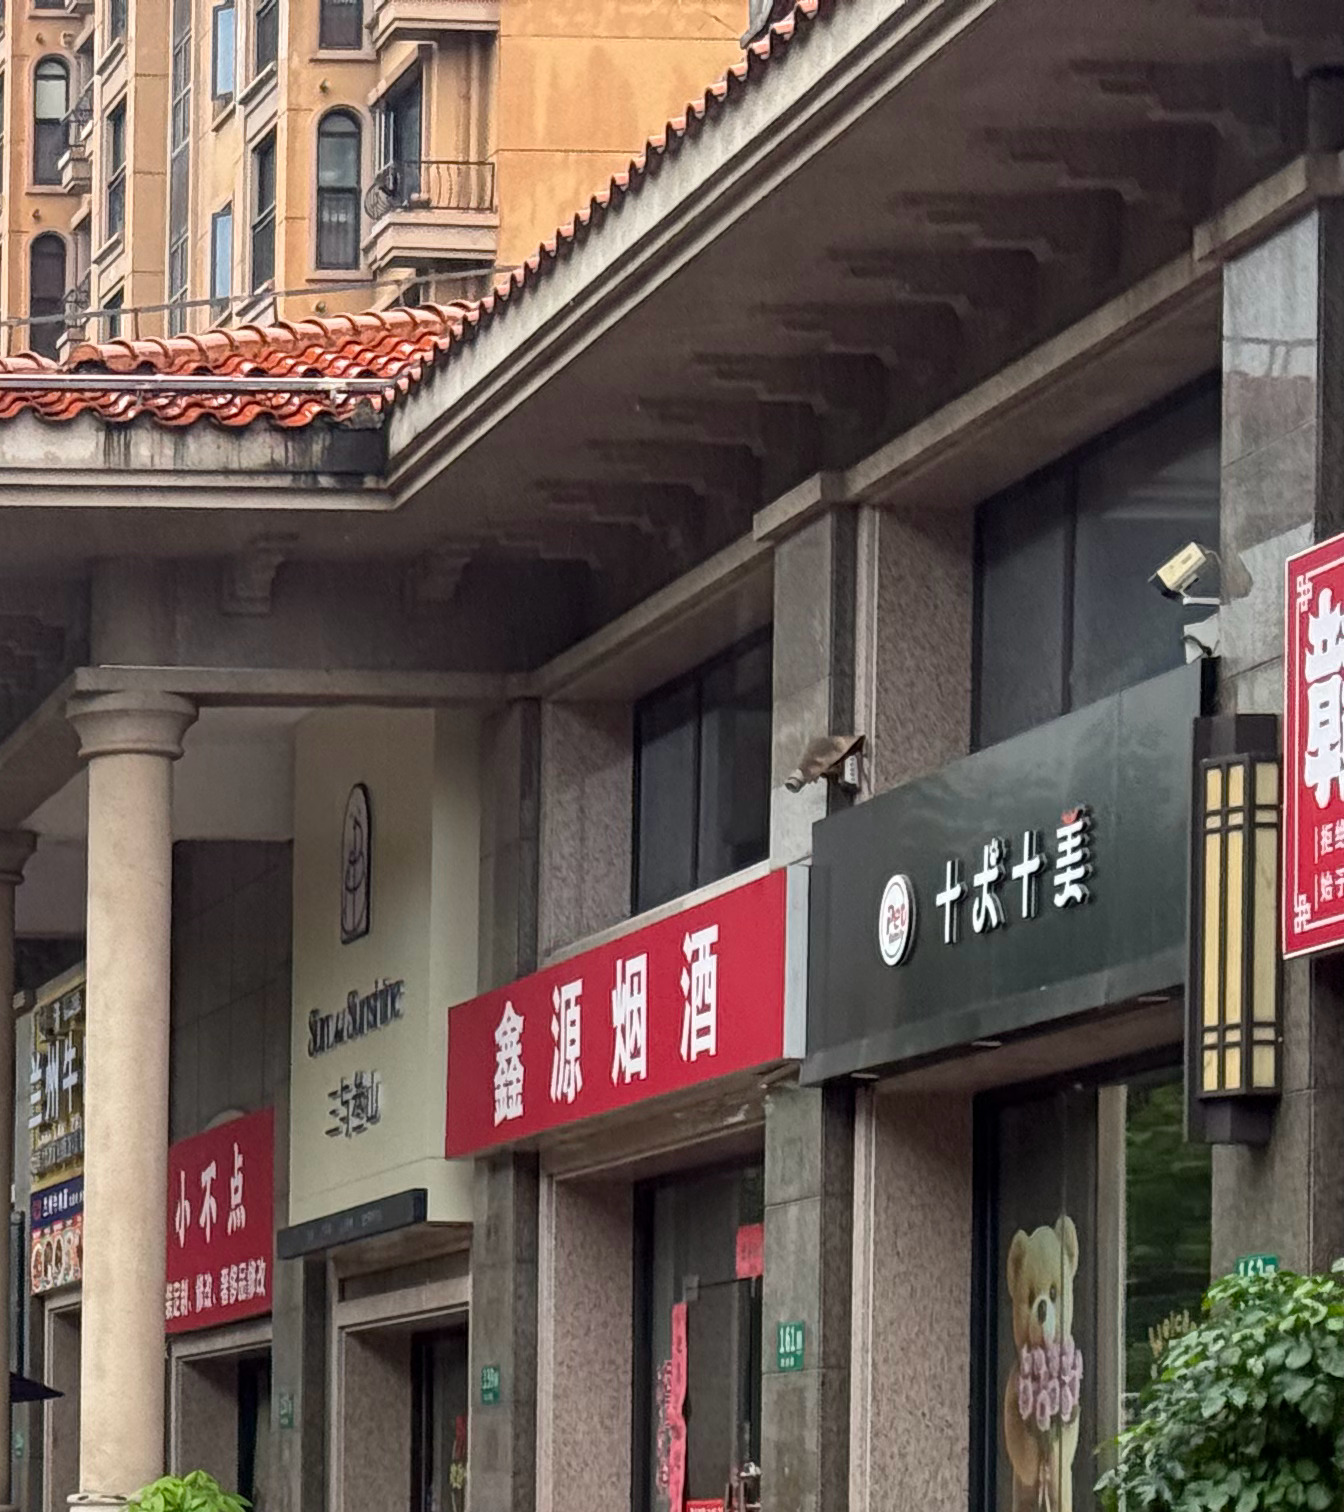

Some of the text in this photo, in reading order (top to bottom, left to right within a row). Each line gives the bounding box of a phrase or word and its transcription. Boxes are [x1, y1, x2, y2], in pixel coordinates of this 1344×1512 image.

[492, 924, 720, 1128] 鑫源烟酒
[28, 1031, 85, 1129] 兰州牛
[175, 1142, 246, 1249] 小不点
